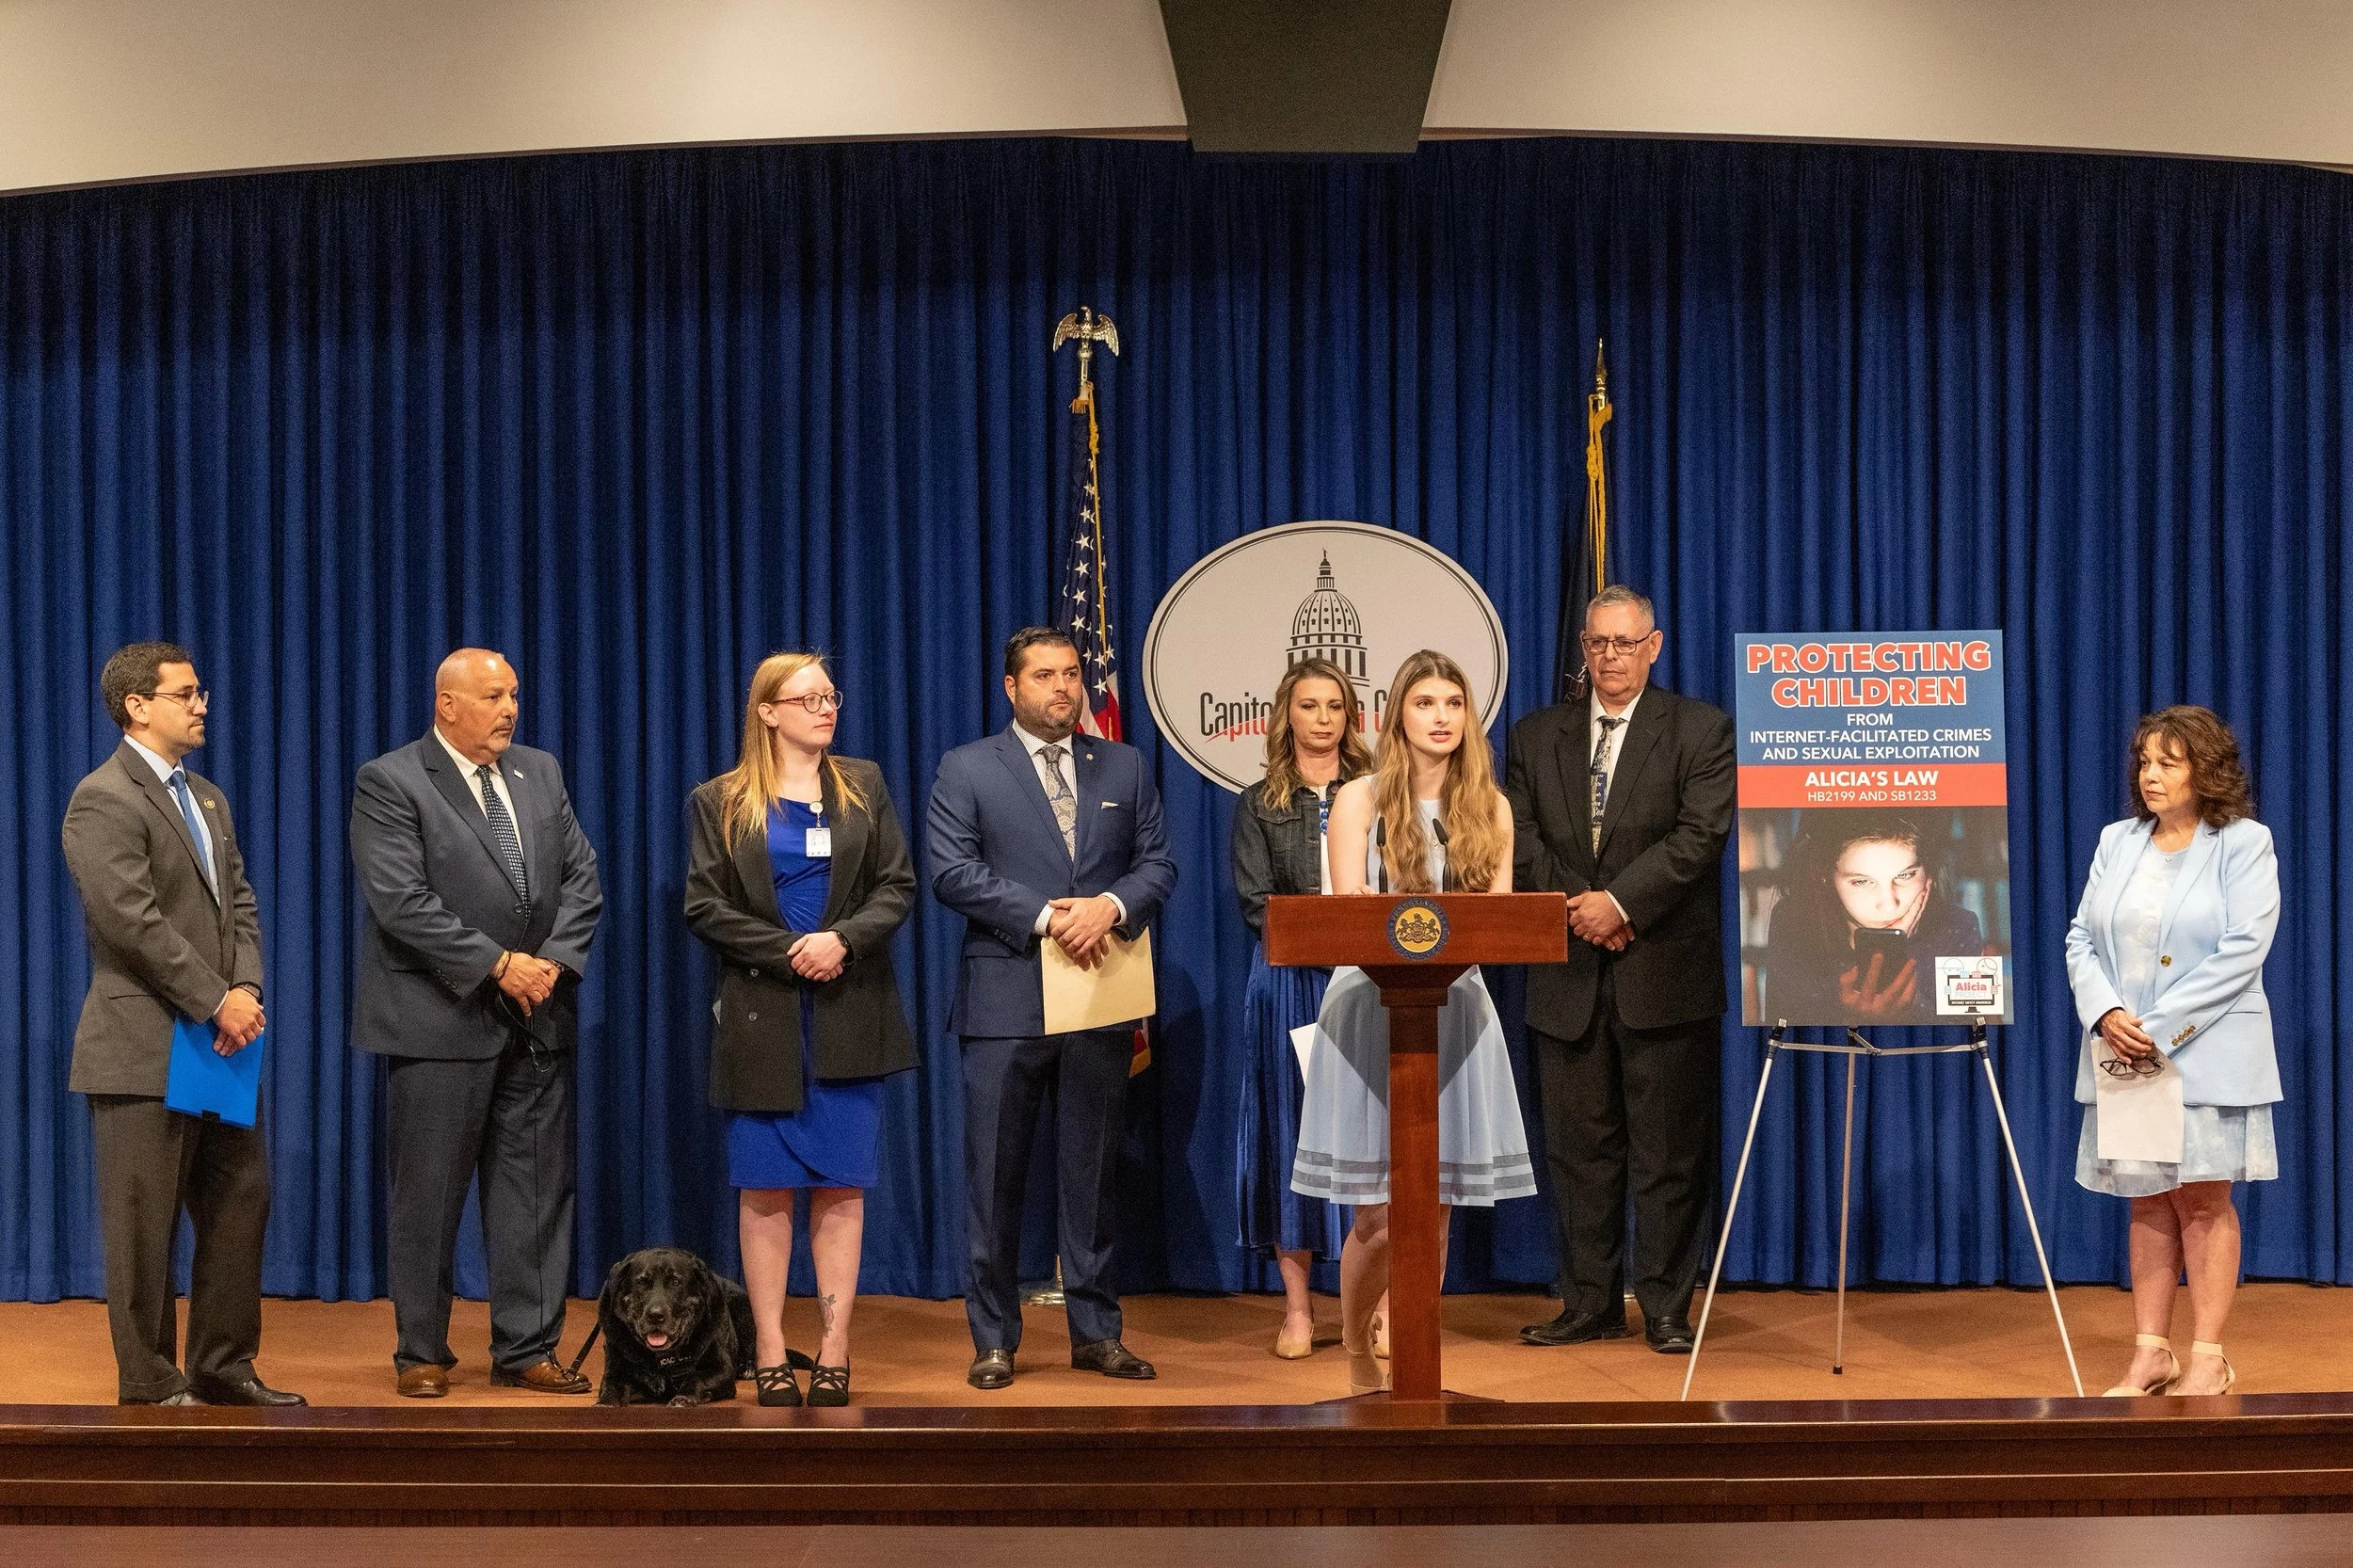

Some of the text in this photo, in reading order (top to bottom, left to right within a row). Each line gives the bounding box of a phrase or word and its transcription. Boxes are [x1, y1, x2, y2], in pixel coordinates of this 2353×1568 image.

[1747, 641, 1991, 673] PROTECTING
[1771, 676, 1966, 708] CHILDREN
[1200, 692, 1273, 742] Capito
[1847, 712, 1894, 727] FROM
[1750, 728, 1992, 744] INTERNET-FACILITATED CRIMES
[1762, 745, 1979, 760] AND SEXUAL EXPLOITATION
[1804, 770, 1939, 787] ALICIA'S LAW
[1807, 790, 1937, 802] HB2199 AND SB1233
[1956, 982, 1987, 991] Alicia
